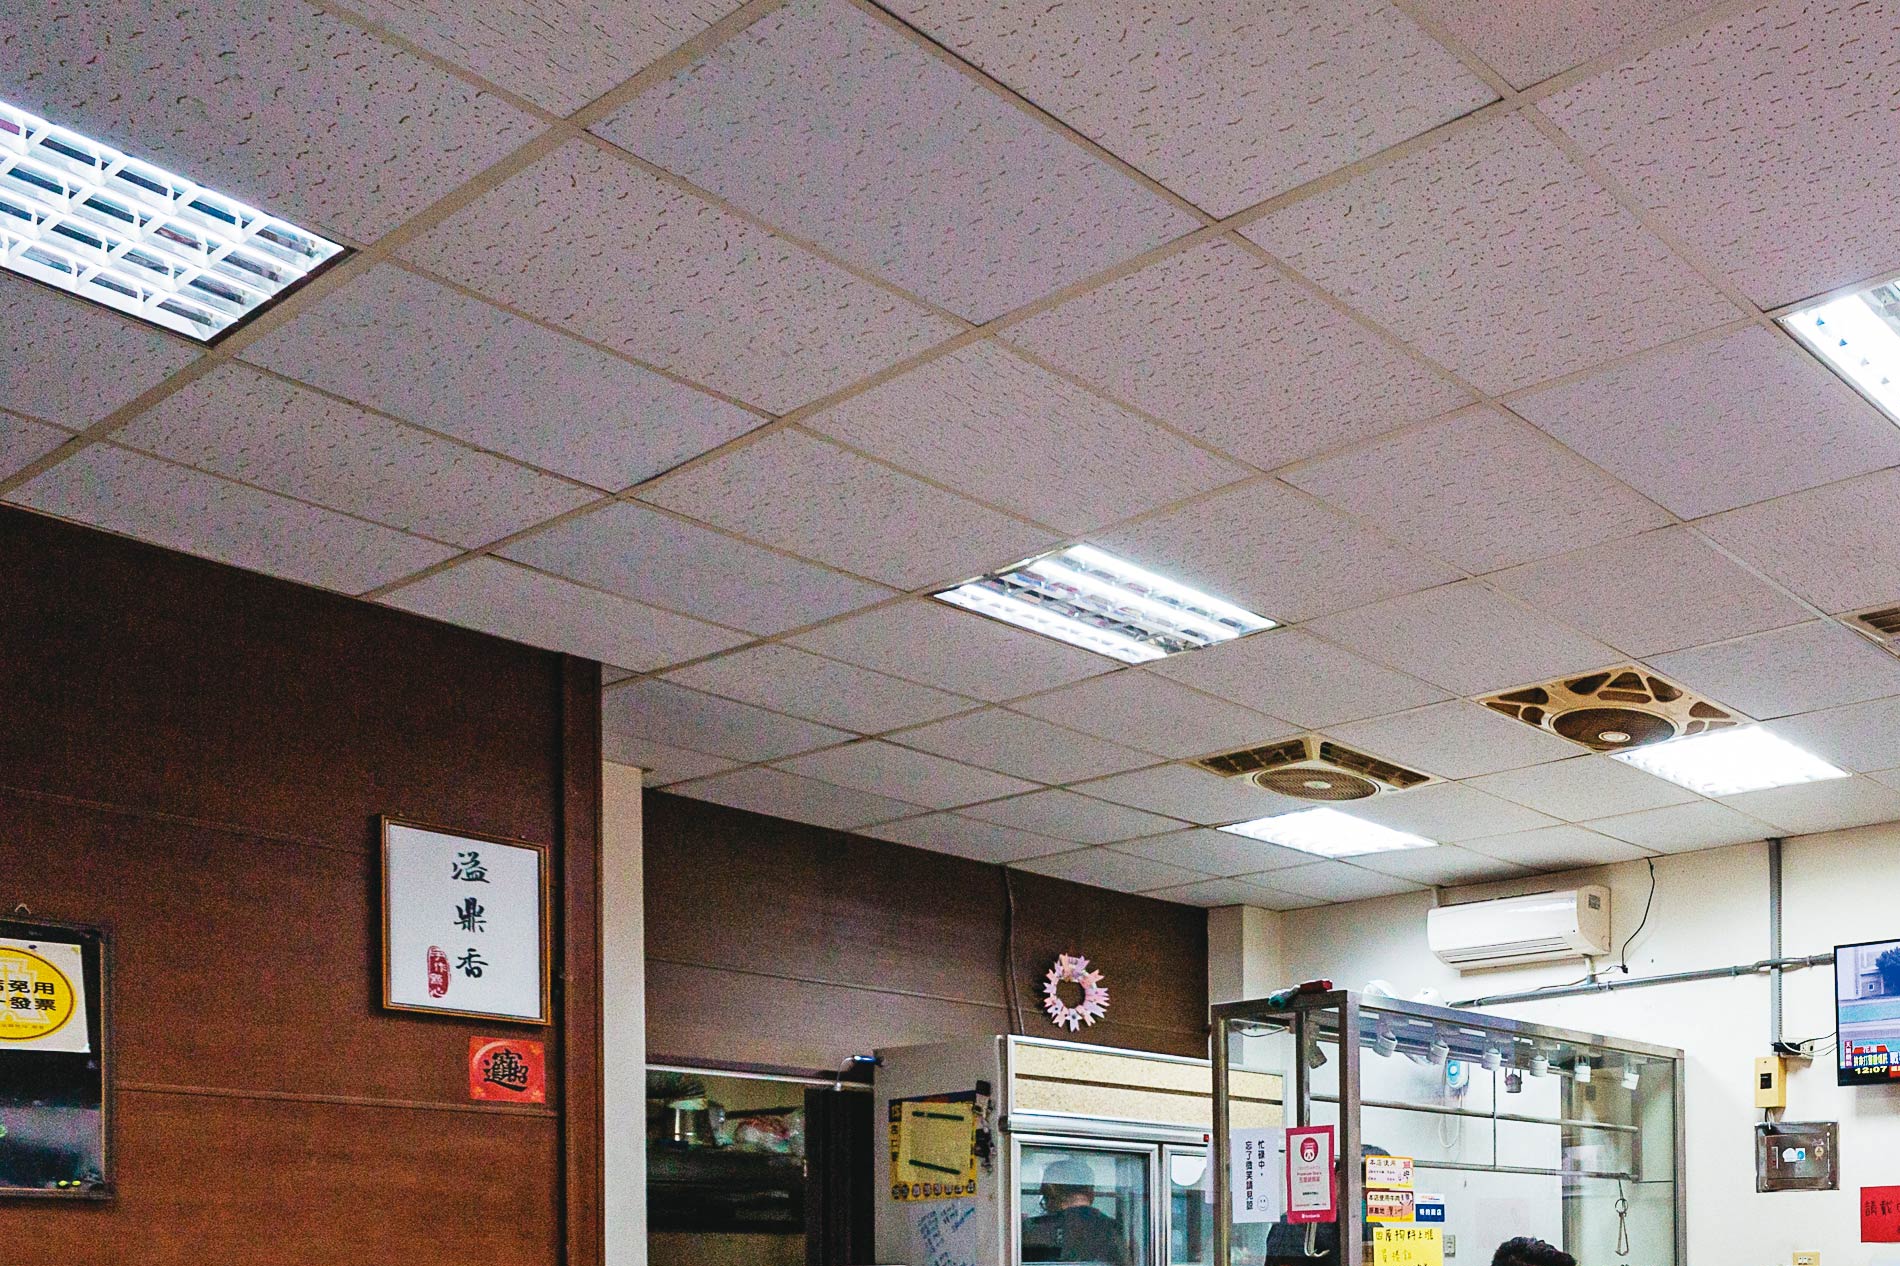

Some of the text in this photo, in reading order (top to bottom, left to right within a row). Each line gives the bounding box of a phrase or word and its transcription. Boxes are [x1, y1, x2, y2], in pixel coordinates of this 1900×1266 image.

[452, 851, 490, 978] 溢鼎香
[0, 979, 55, 995] 免用
[0, 996, 57, 1011] 發票
[1854, 1065, 1888, 1075] 12:07
